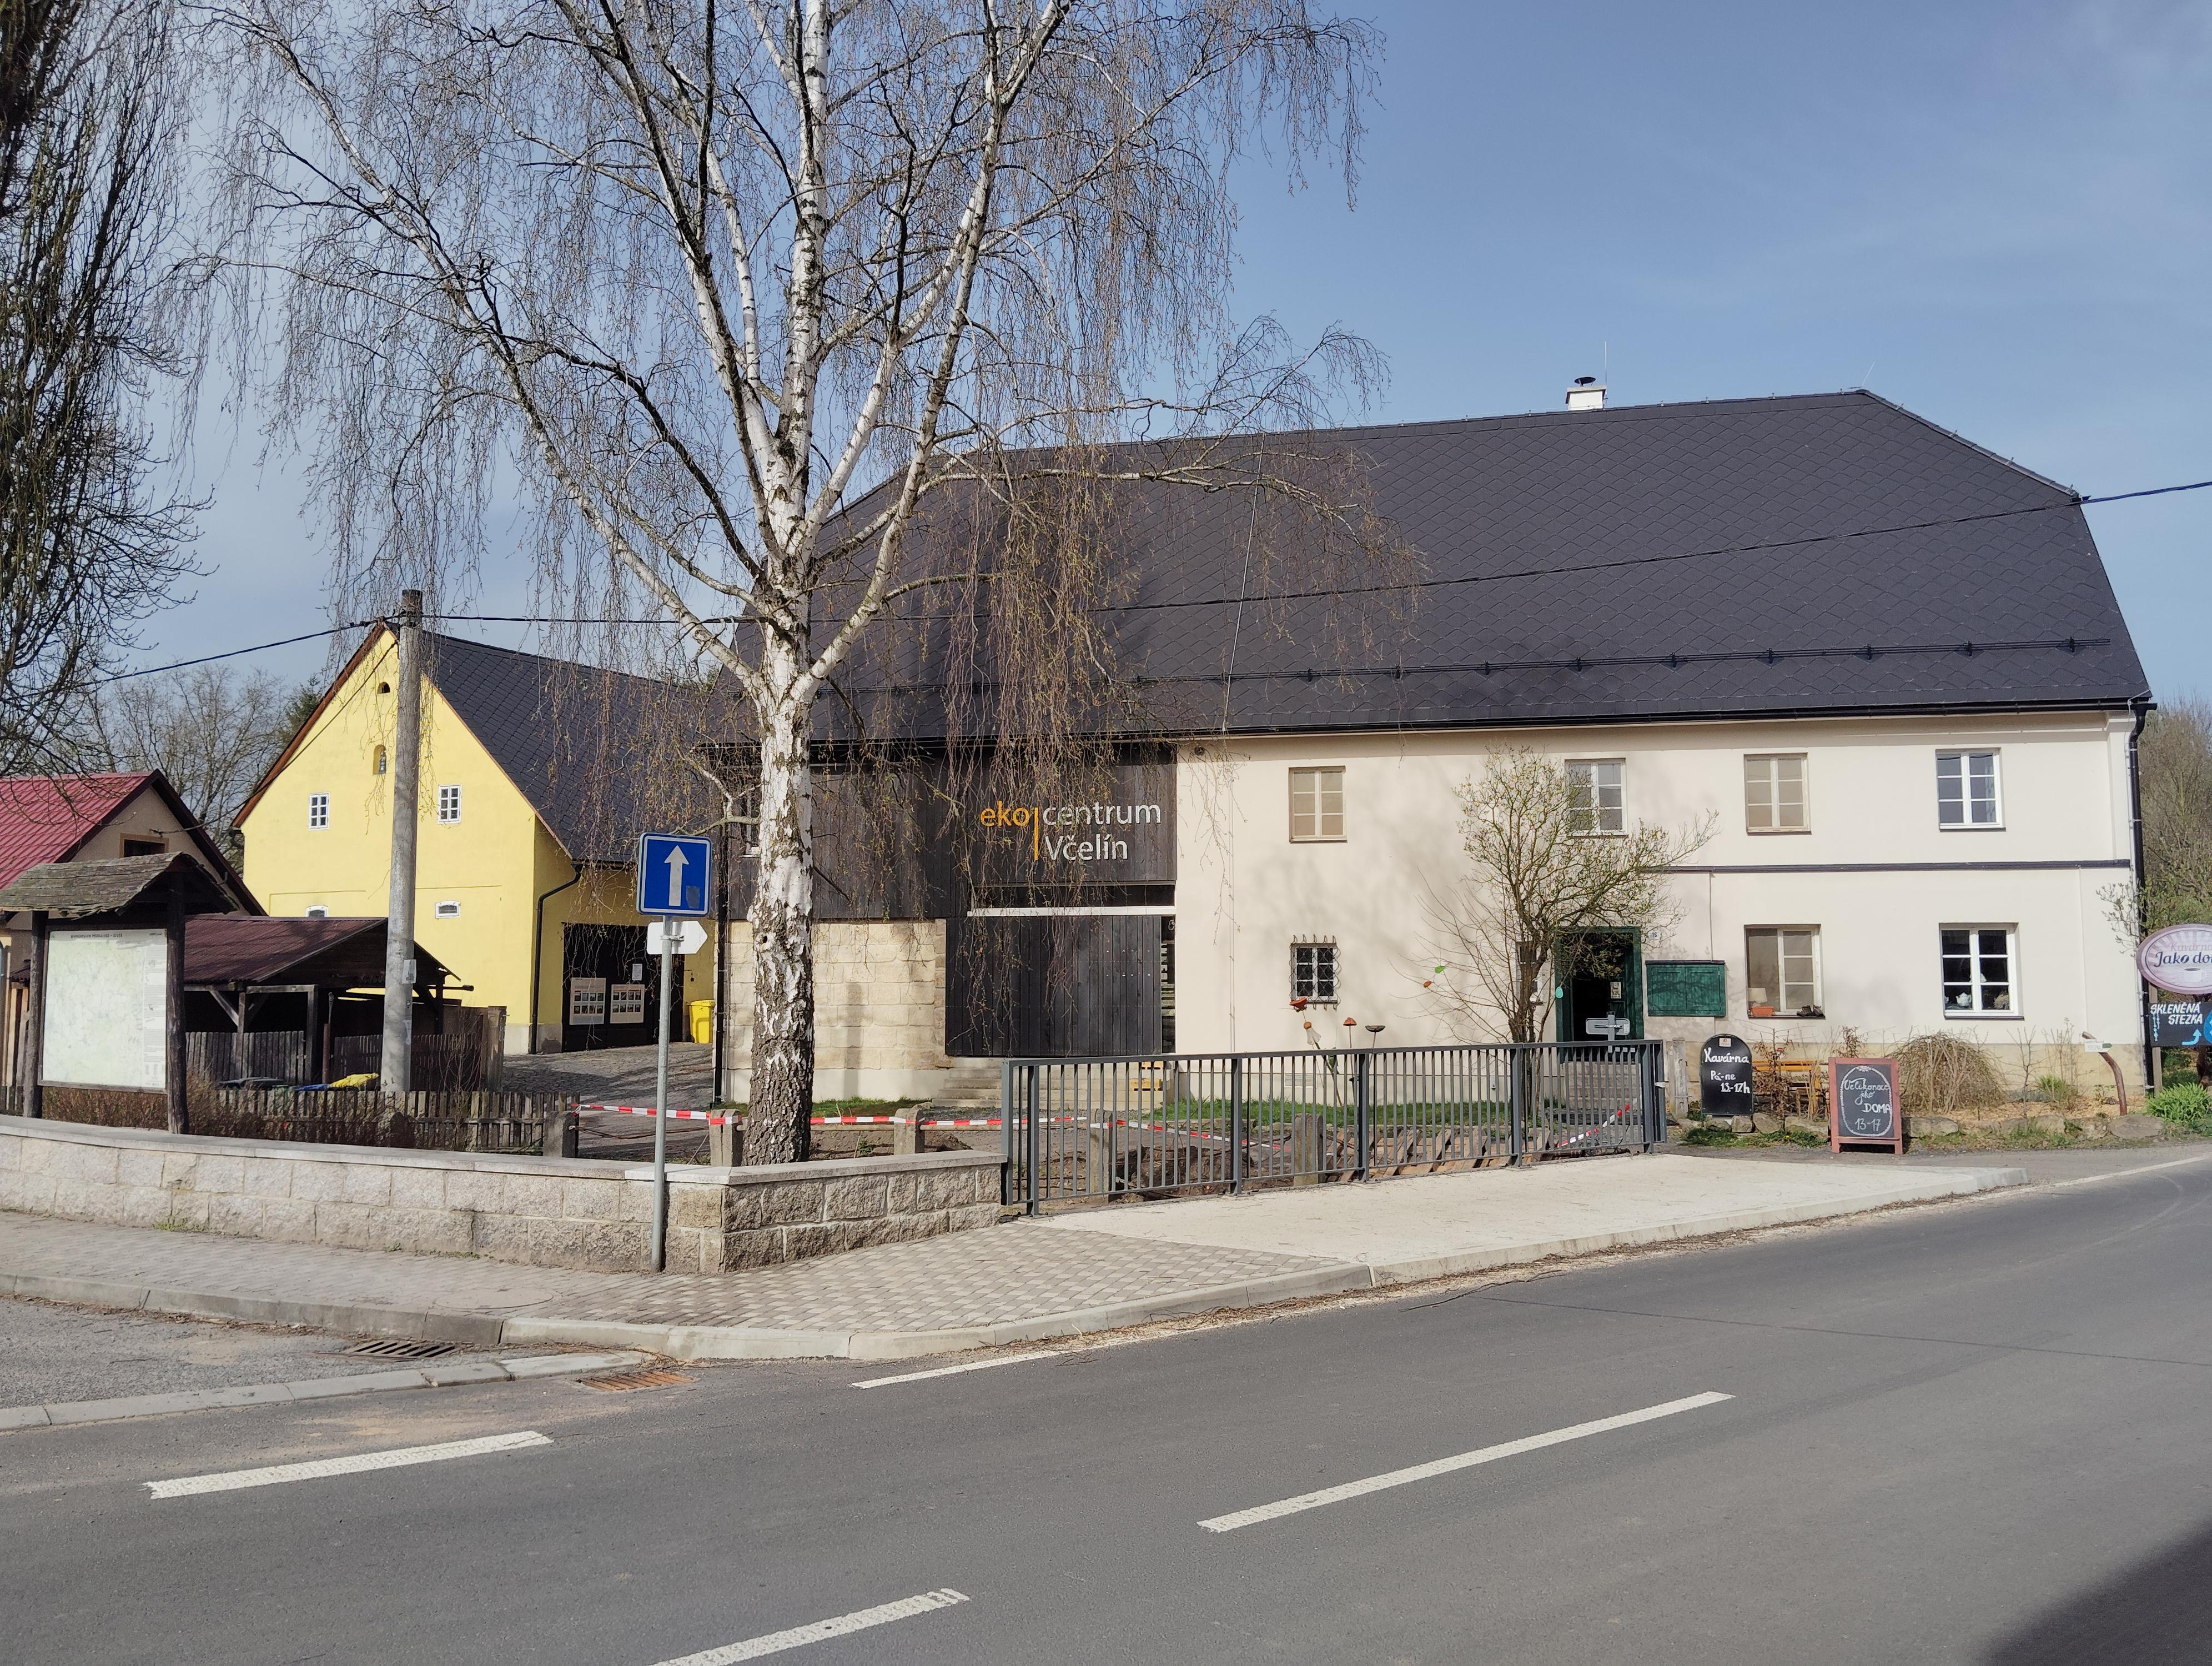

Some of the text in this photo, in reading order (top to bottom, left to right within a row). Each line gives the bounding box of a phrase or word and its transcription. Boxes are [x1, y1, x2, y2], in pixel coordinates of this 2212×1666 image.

[979, 800, 1162, 827] eko centrum
[1045, 833, 1128, 860] Včelín
[2154, 951, 2212, 967] Jako do
[2150, 1001, 2201, 1014] SKLENĚNÁ
[2168, 1013, 2203, 1025] STEZKA
[1704, 1047, 1749, 1063] Kavárna
[1861, 1103, 1892, 1113] DOMA
[1855, 1118, 1881, 1132] 13-17
